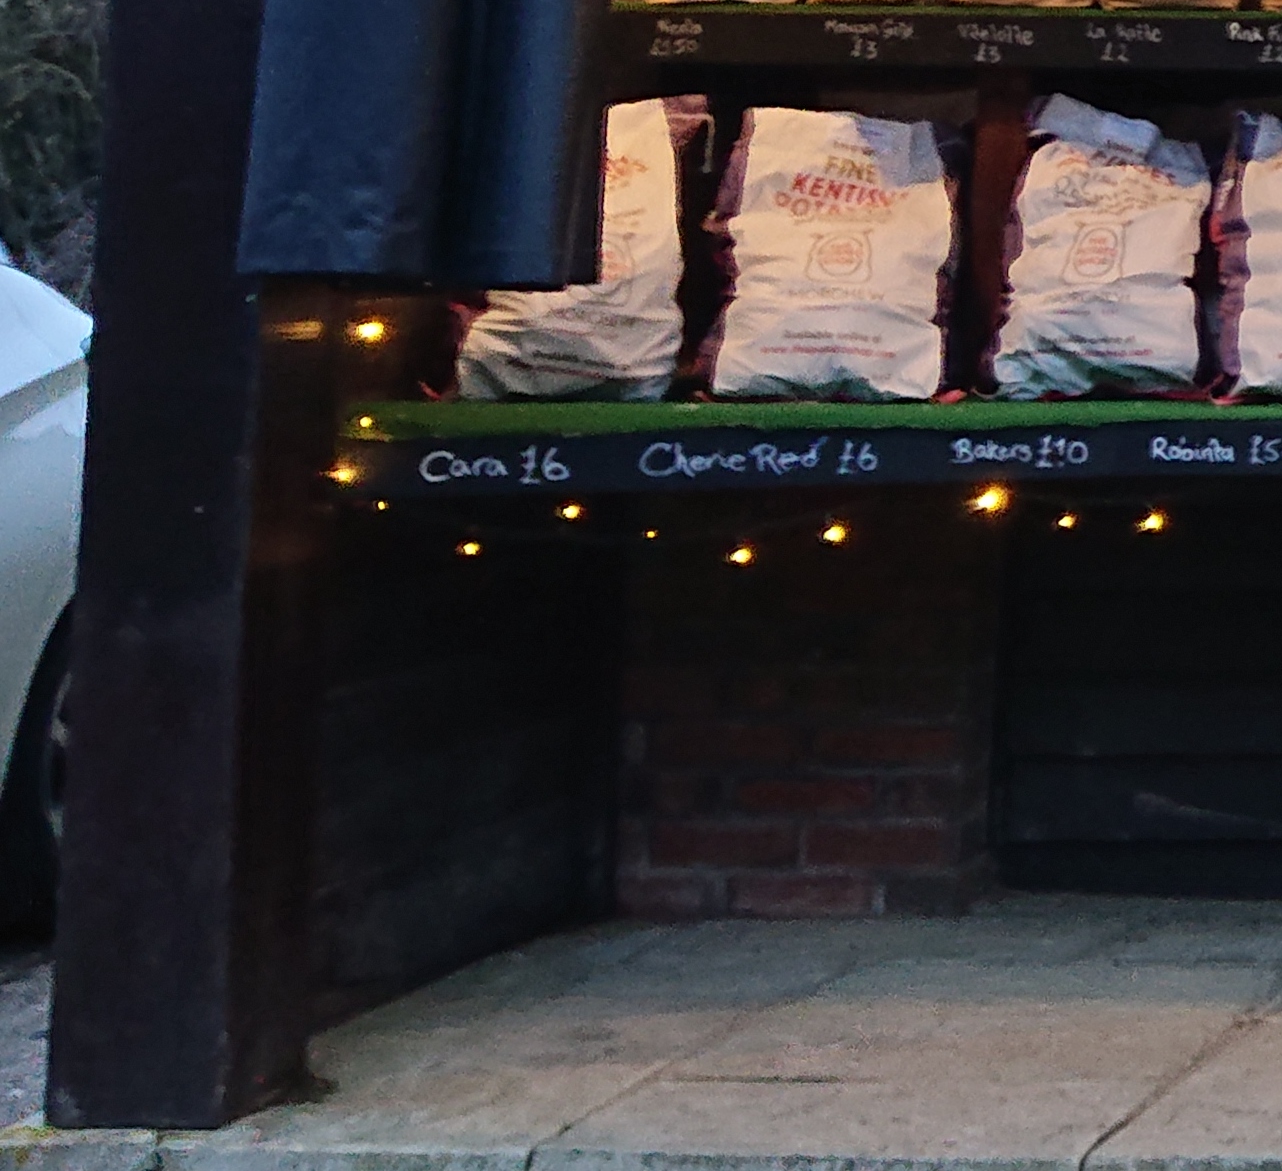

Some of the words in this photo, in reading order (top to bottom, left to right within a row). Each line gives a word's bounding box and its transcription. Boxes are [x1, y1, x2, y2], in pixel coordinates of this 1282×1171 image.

[416, 447, 510, 484] Cara
[517, 443, 573, 486] £6
[747, 434, 830, 477] Red
[834, 438, 880, 477] £6
[947, 435, 1034, 465] Bakers
